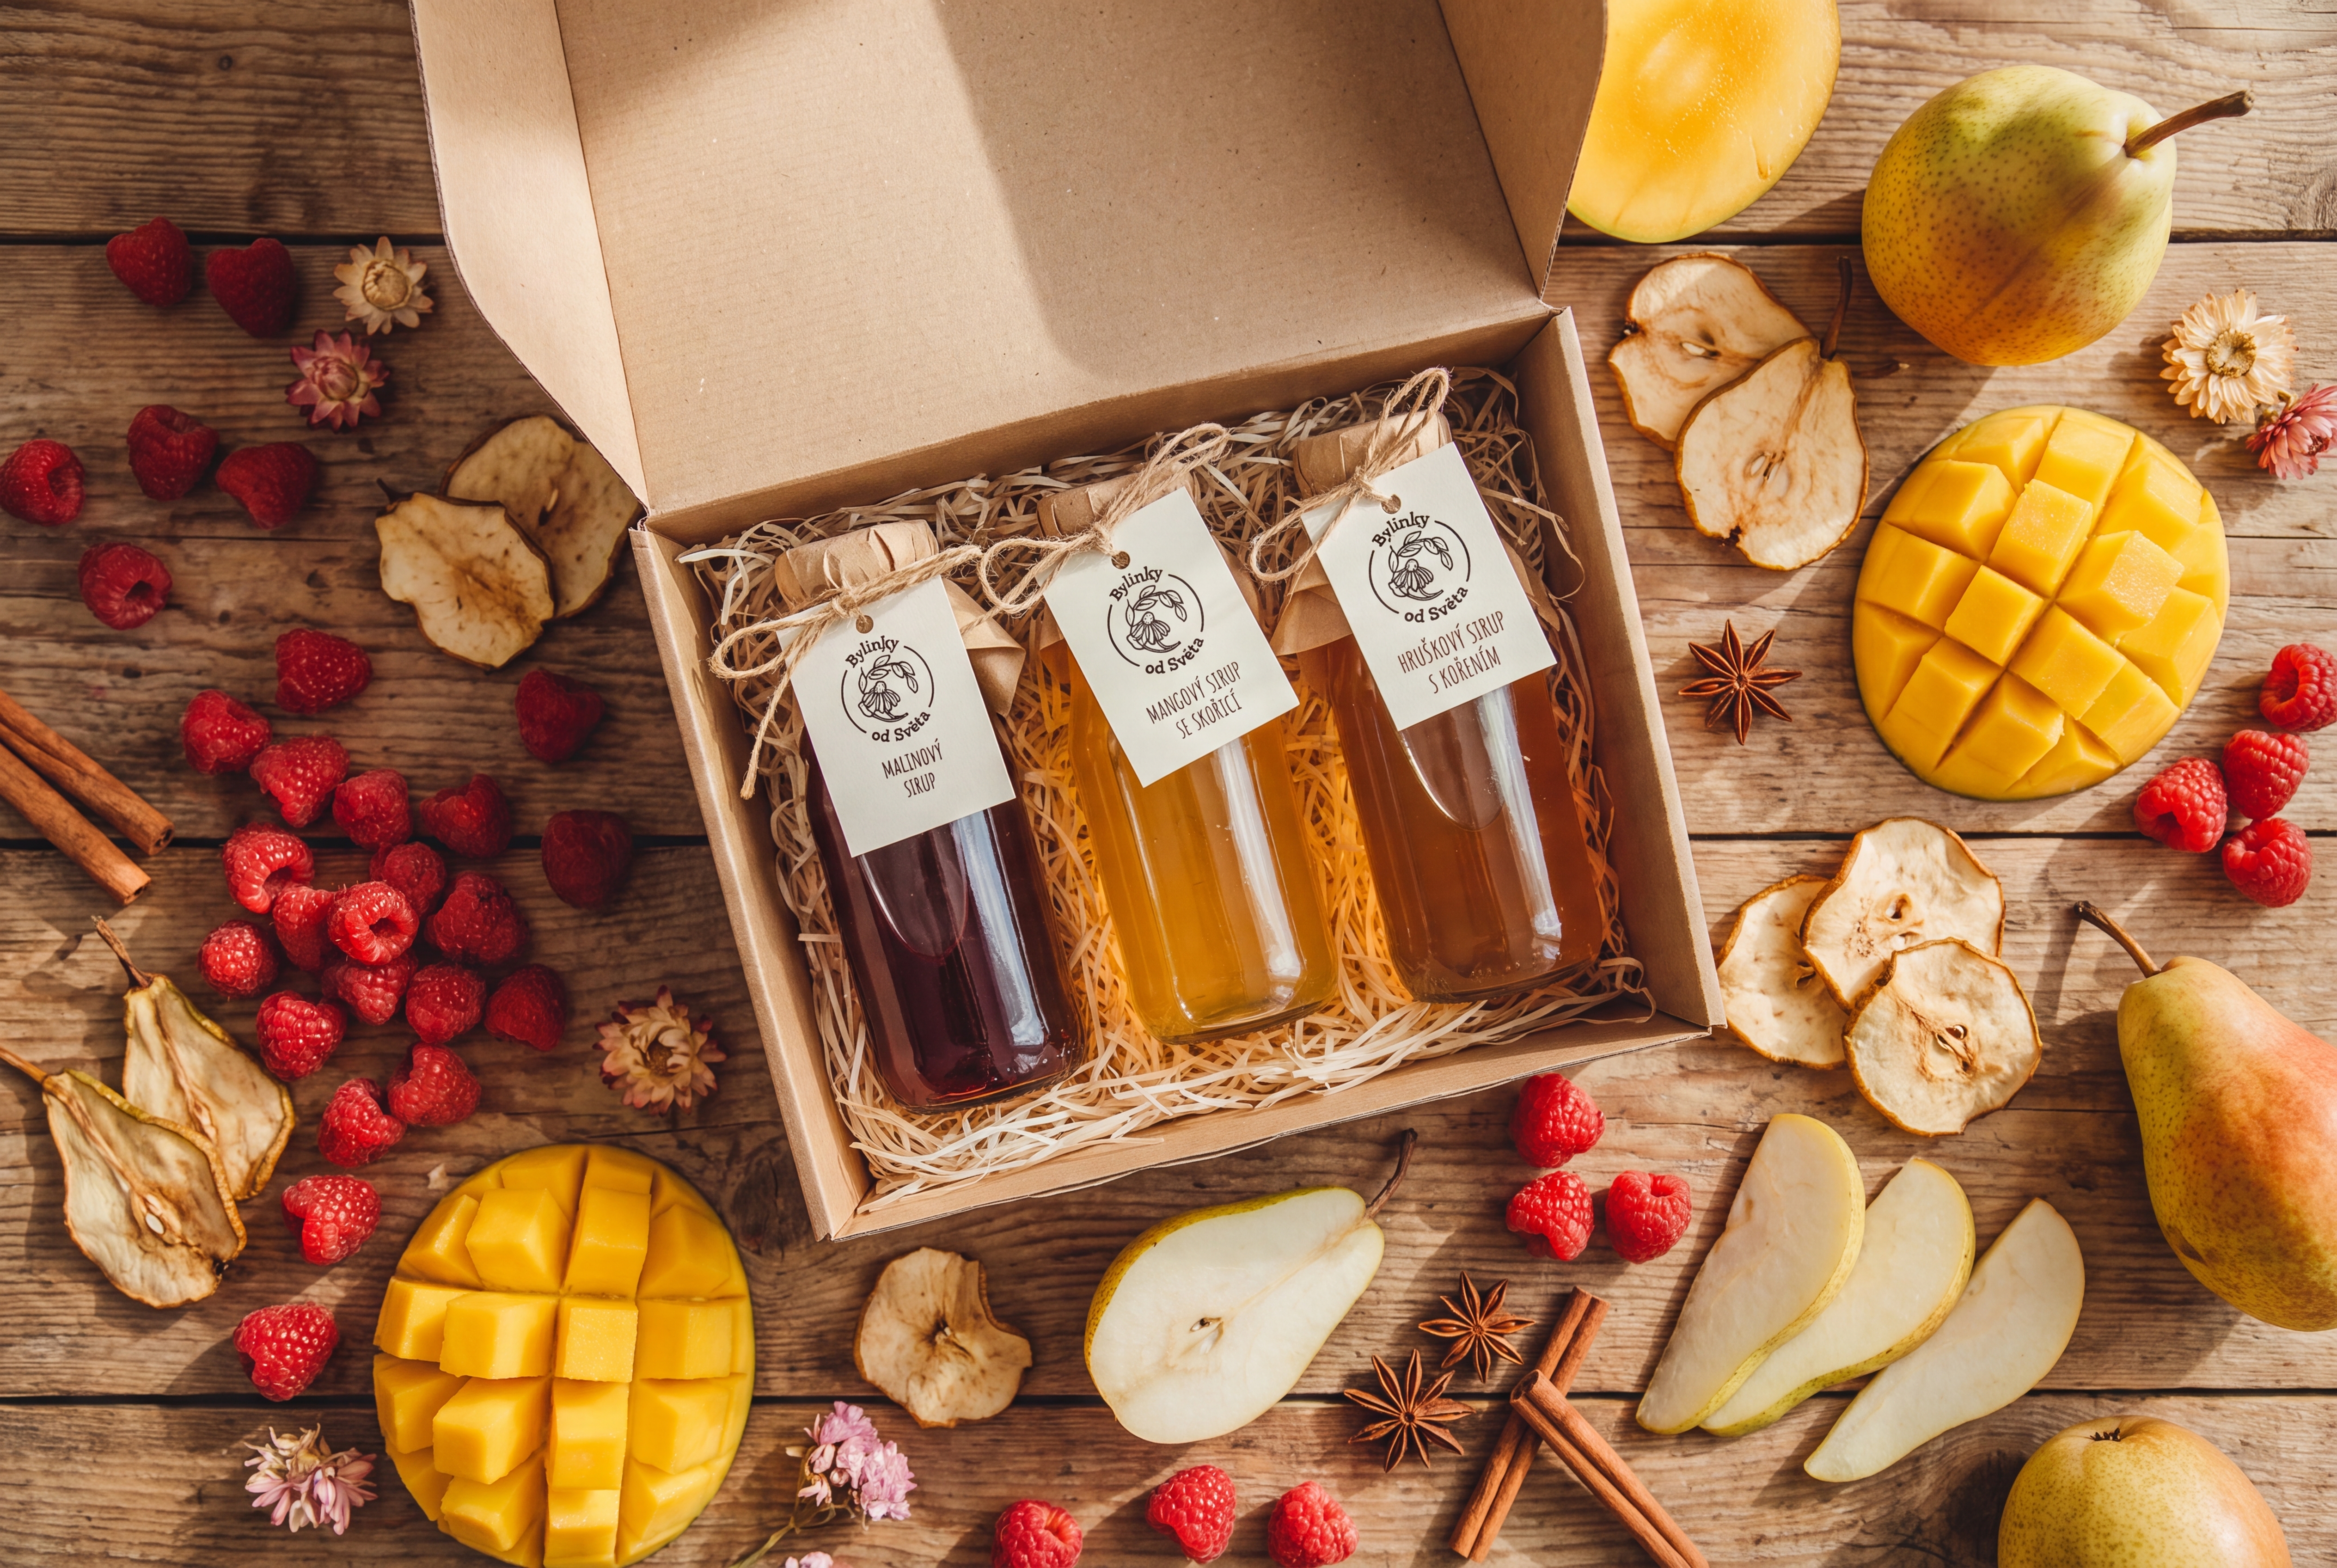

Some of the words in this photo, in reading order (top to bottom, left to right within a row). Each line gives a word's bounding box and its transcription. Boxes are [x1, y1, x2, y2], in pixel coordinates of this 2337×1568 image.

[1372, 511, 1430, 547] Bylinky
[1109, 566, 1163, 601] Bylinky
[1405, 609, 1425, 623] od
[845, 636, 899, 668] Bylinky
[1398, 623, 1464, 673] HRUŠKOVÝ
[1467, 611, 1504, 643] SIRUP
[1145, 661, 1165, 674] od
[1429, 674, 1438, 693] S
[1440, 645, 1500, 688] KOŘENÍM
[1146, 676, 1205, 724] MANGOVÝ
[1206, 662, 1240, 693] SIRUP
[1176, 718, 1192, 739] SE
[1192, 688, 1242, 730] SKOŘICÍ
[872, 729, 890, 742] od
[882, 738, 942, 778] MALINOVÝ
[904, 772, 935, 797] SIRUP
